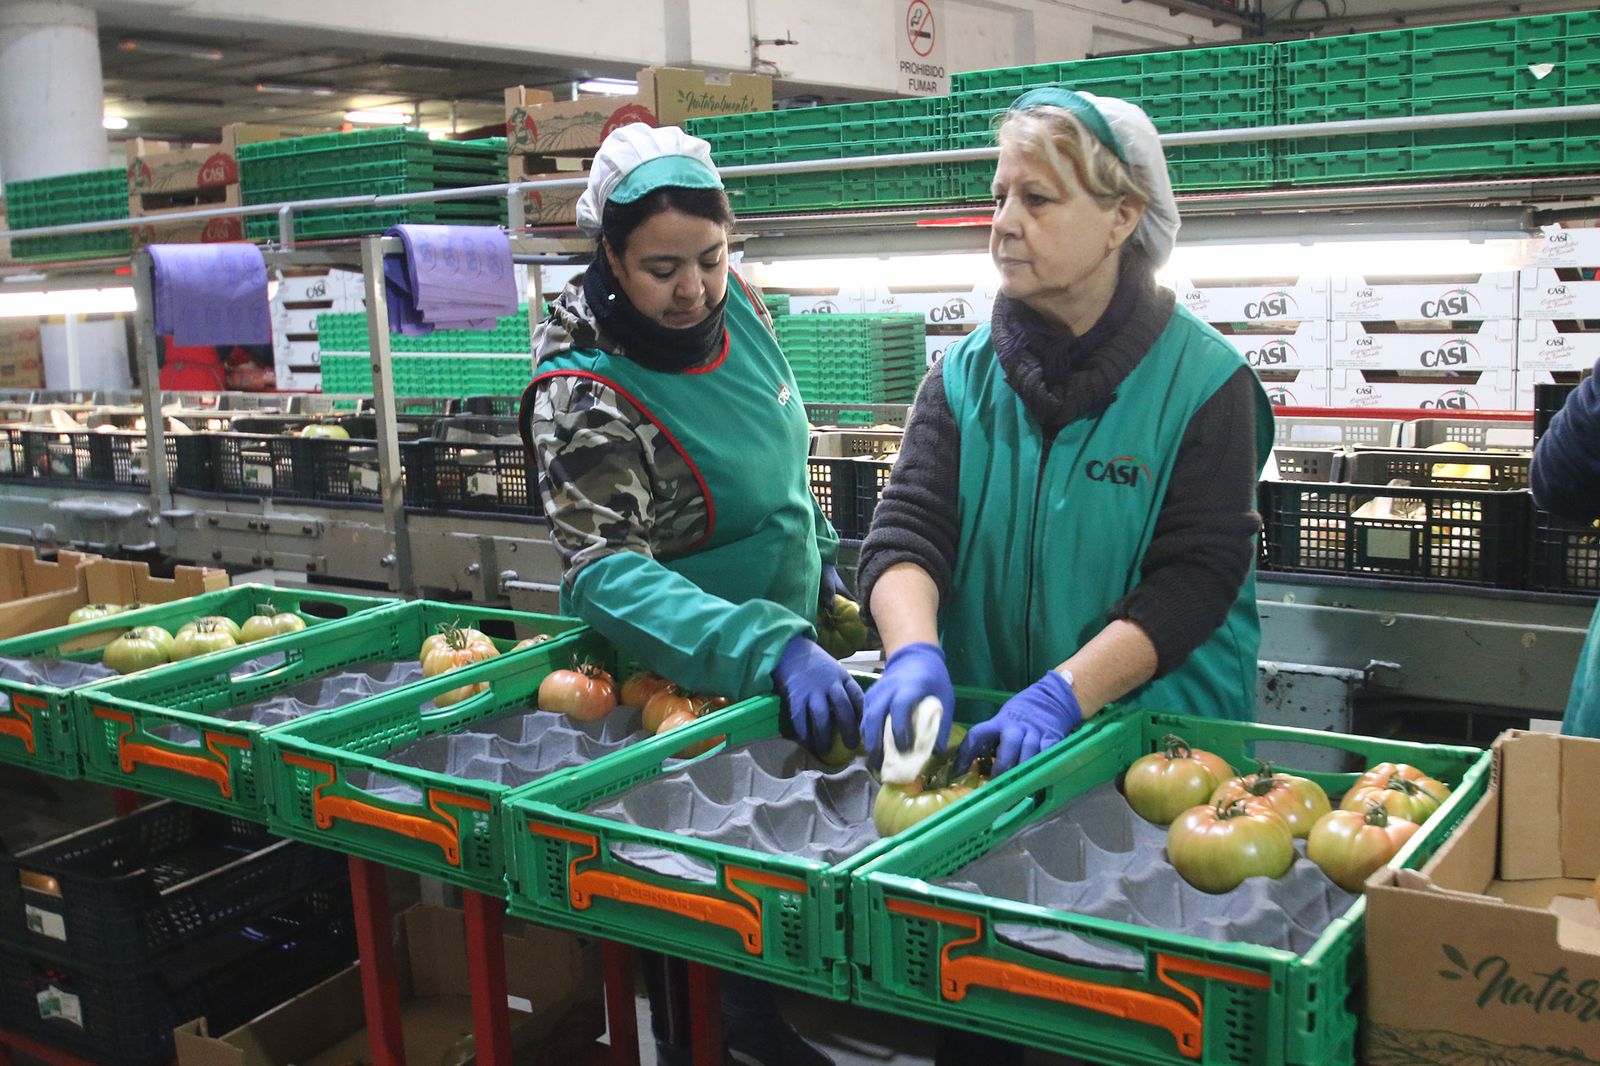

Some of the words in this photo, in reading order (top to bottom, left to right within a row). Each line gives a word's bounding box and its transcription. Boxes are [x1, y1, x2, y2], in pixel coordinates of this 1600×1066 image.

[900, 60, 945, 79] PROHIBIDO
[908, 78, 937, 93] FUMAR
[202, 166, 225, 182] CASI
[1550, 232, 1568, 243] CASI
[306, 284, 326, 299] CASI
[1356, 290, 1374, 298] CASI
[1547, 286, 1566, 296] CASI
[930, 303, 966, 323] CASI
[1244, 298, 1287, 319] CASI
[1420, 296, 1469, 319] CASI
[1356, 338, 1374, 346] CASI
[1546, 337, 1565, 347] CASI
[1245, 346, 1287, 367] CASI
[1420, 345, 1468, 368] CASI
[1356, 387, 1373, 396] CASI
[1086, 459, 1139, 488] CASI
[1474, 956, 1600, 1022] Natur
